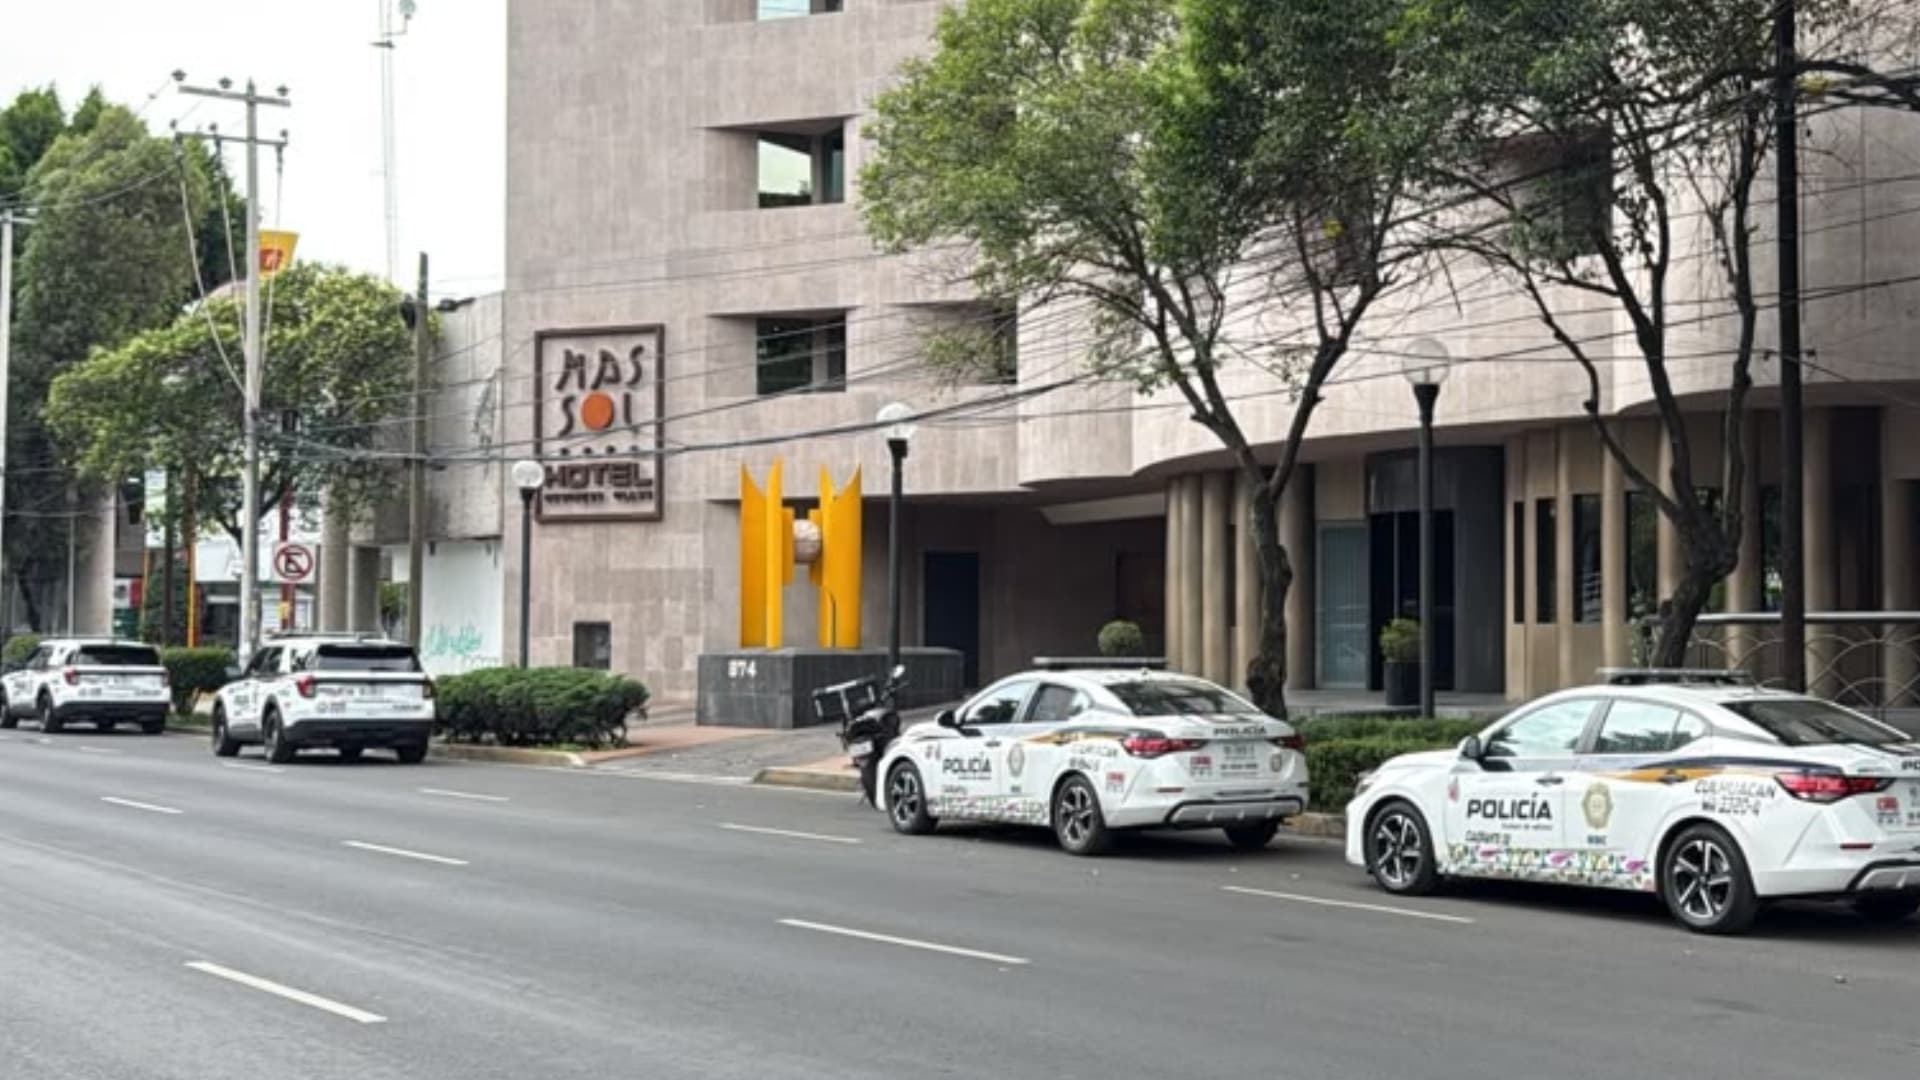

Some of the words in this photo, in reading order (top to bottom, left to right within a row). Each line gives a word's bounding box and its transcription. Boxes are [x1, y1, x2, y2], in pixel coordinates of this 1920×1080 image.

[555, 345, 644, 390] MAS
[545, 463, 653, 488] HOTEL
[943, 752, 992, 773] POLICÍA
[1467, 792, 1552, 818] POLICÍA
